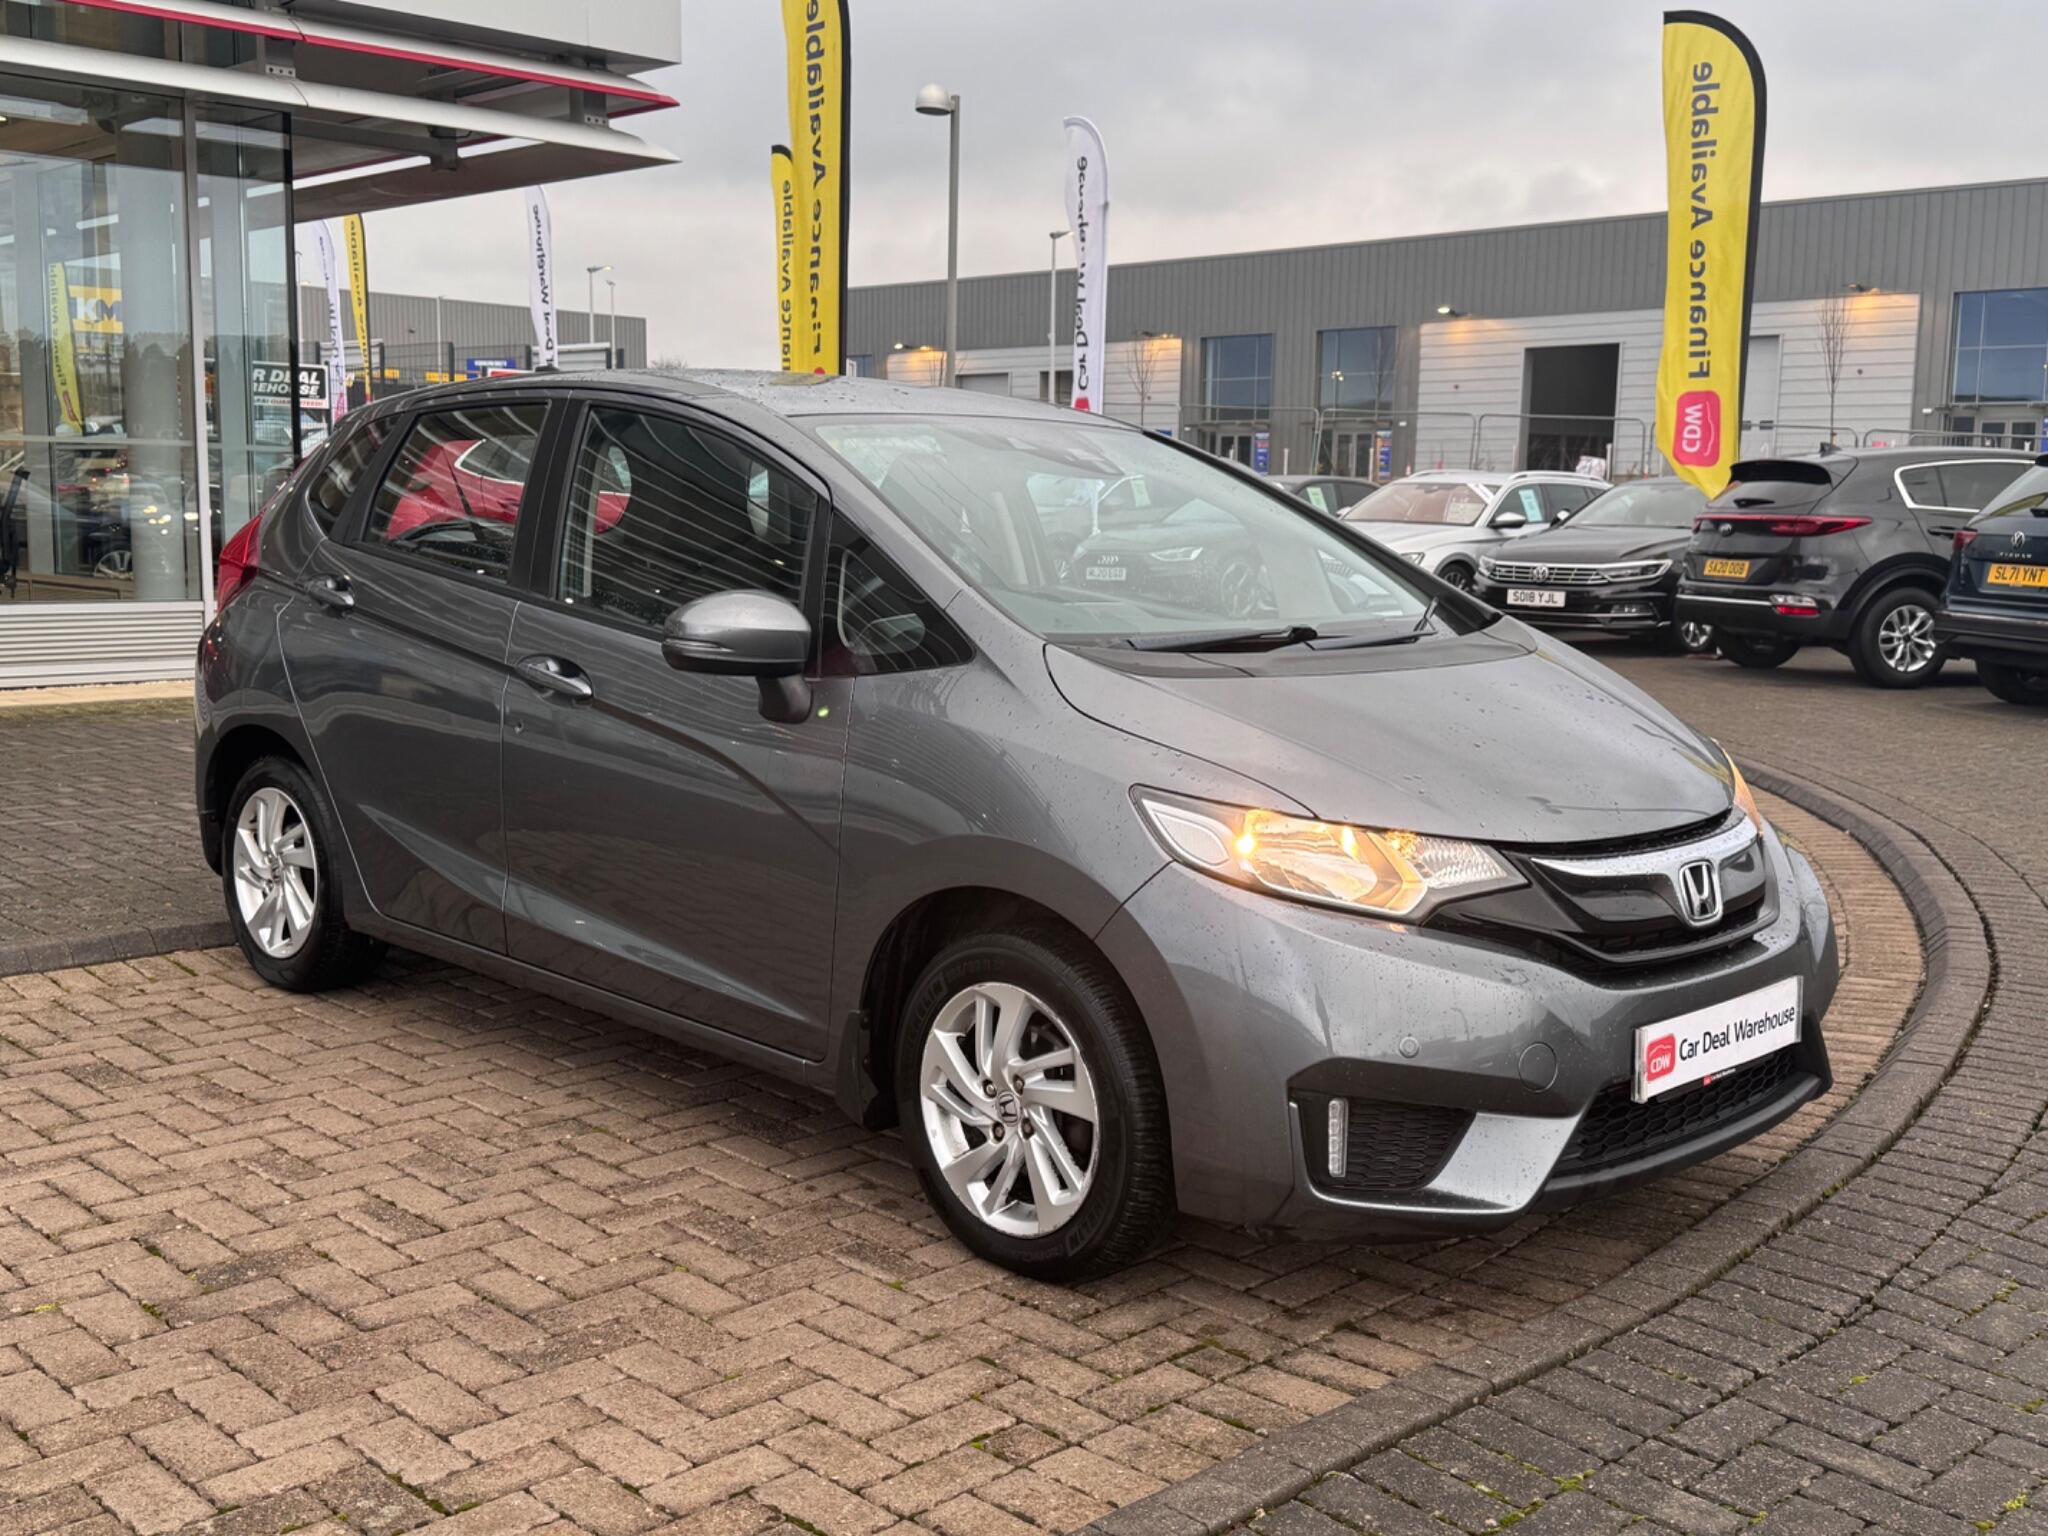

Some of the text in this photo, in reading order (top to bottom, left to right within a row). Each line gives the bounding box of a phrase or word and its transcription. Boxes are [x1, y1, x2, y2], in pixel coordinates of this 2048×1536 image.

[1994, 566, 2046, 583] SL71 YNT
[1538, 592, 1558, 604] YJL
[1679, 1006, 1795, 1061] Car Deal Warehouse
[1650, 1052, 1672, 1074] CDW
